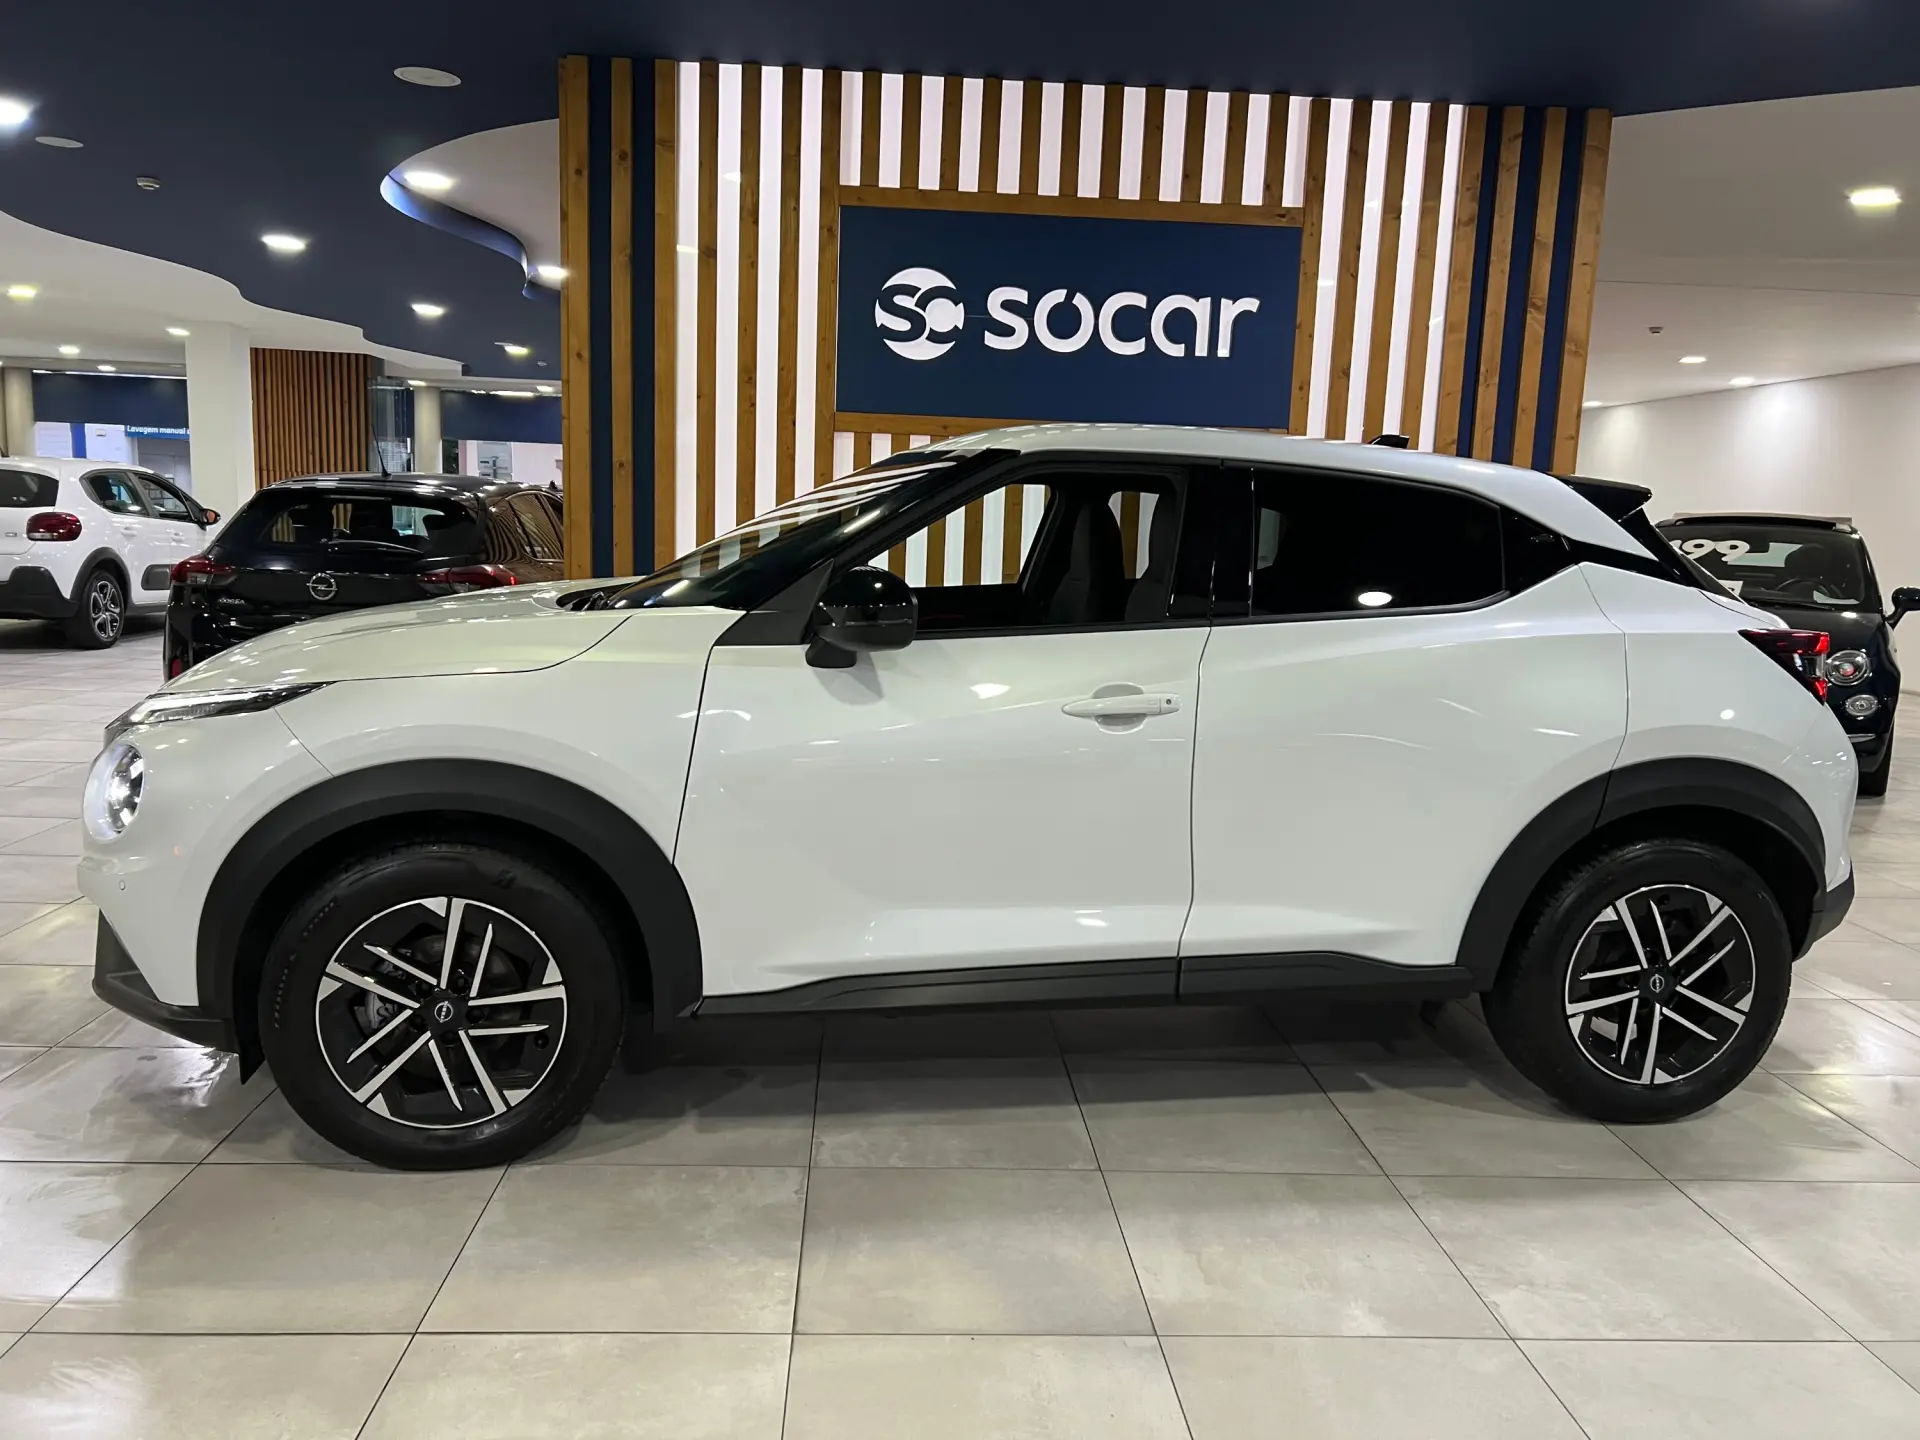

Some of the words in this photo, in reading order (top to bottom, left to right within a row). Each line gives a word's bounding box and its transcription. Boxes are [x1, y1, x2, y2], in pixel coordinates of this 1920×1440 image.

[984, 286, 1261, 358] socar
[127, 425, 158, 435] Lavagem
[160, 427, 186, 435] manual
